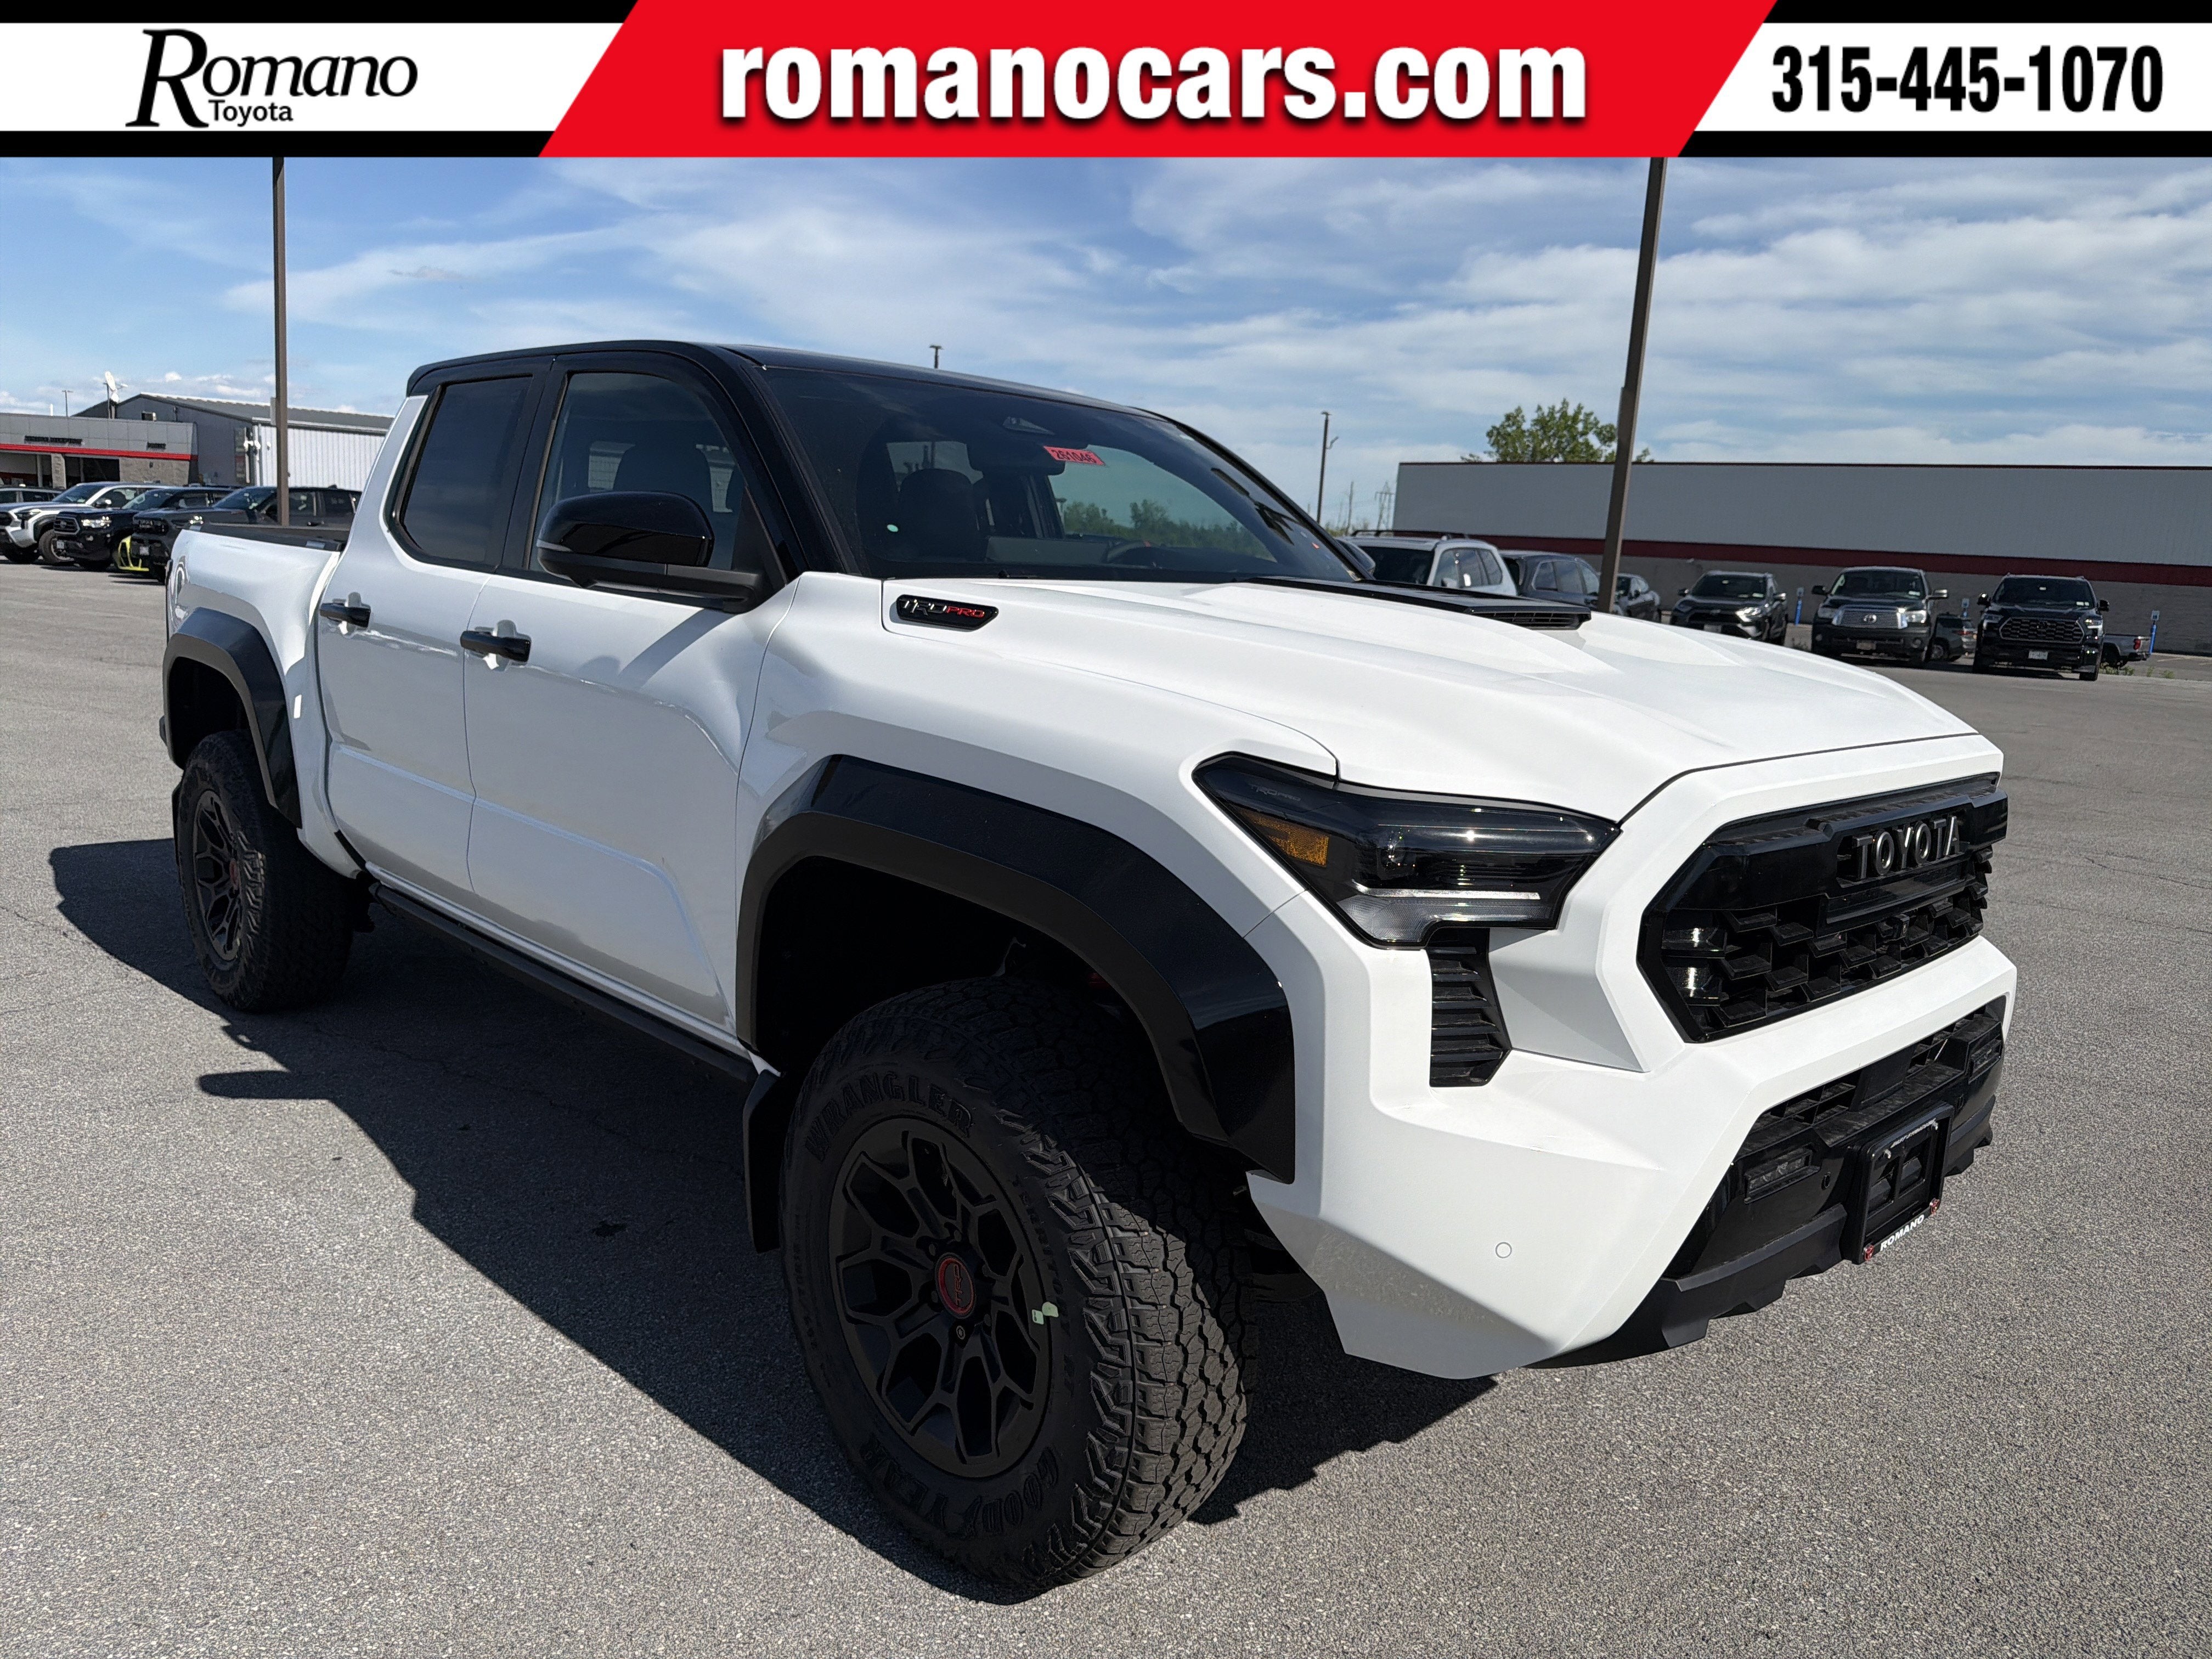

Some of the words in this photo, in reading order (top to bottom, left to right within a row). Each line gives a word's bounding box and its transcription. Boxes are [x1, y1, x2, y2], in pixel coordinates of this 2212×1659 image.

[946, 605, 985, 618] PRO
[1855, 815, 1960, 881] TOYOTA
[805, 1071, 973, 1161] WRANGLER
[1880, 1214, 1925, 1252] ROMANO
[859, 1434, 1059, 1538] GOODYEAR
